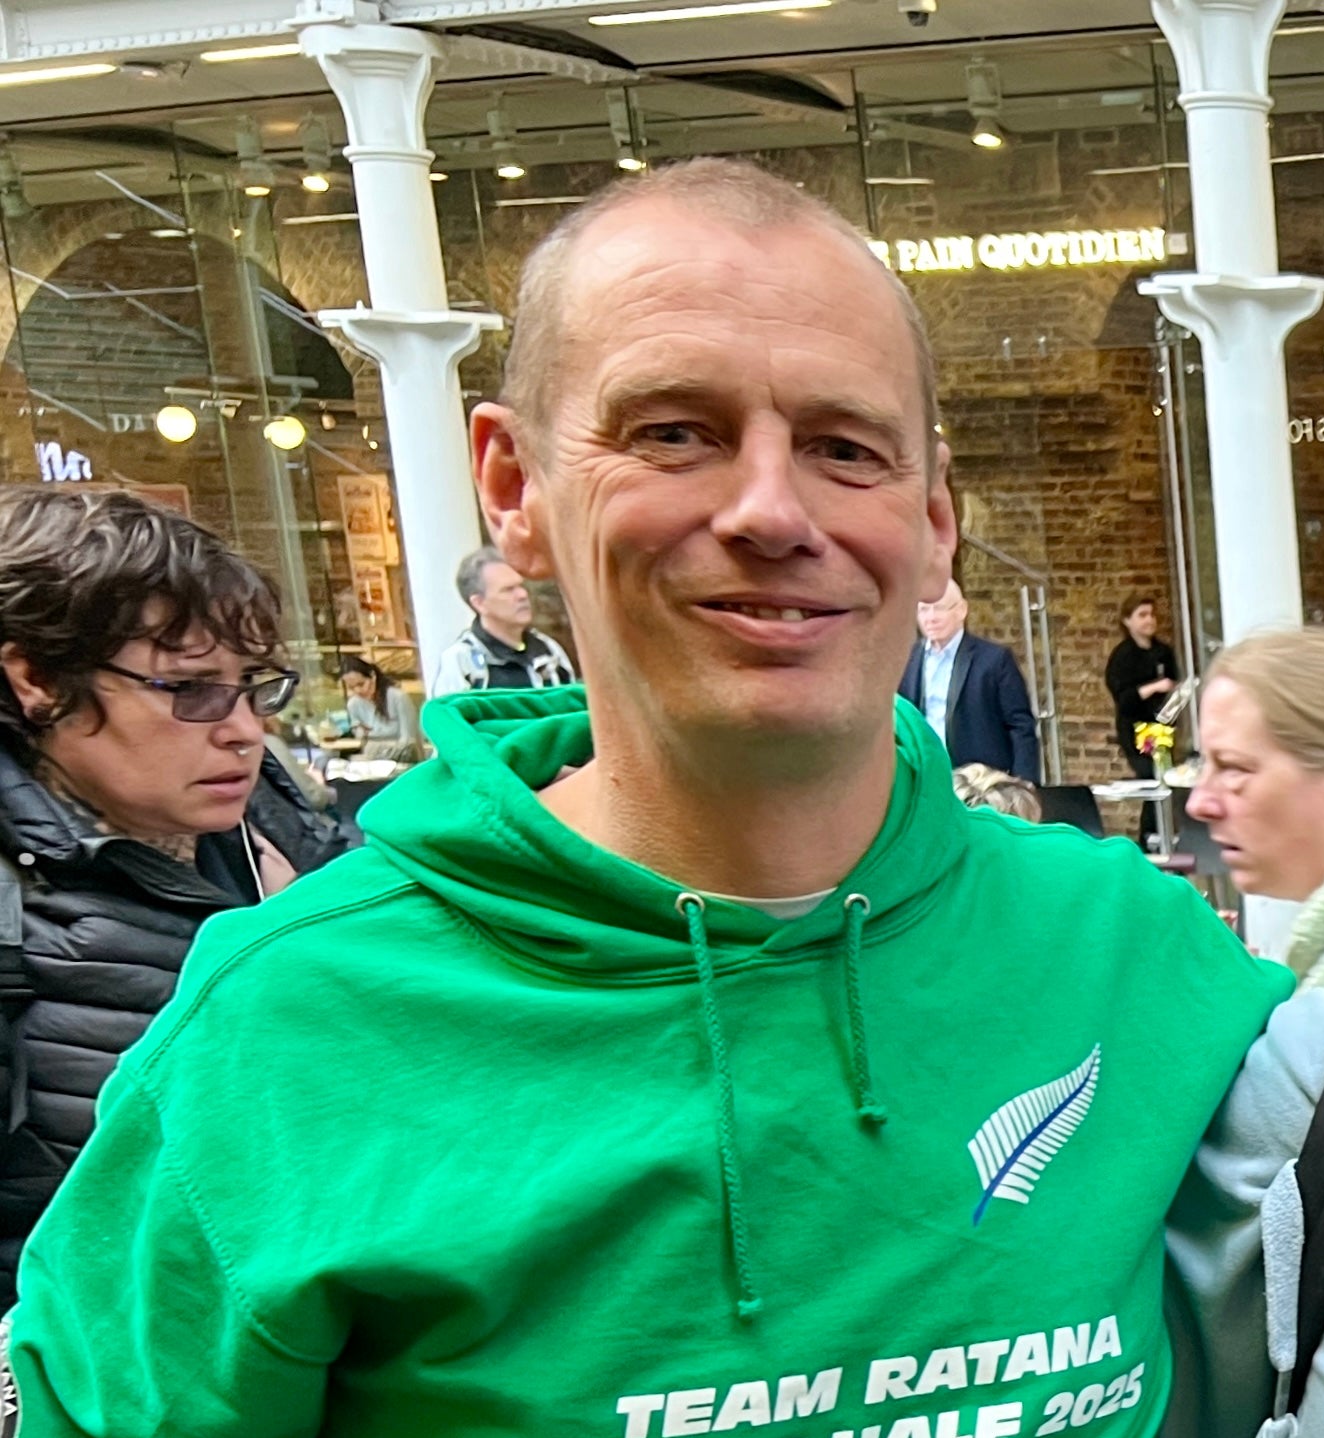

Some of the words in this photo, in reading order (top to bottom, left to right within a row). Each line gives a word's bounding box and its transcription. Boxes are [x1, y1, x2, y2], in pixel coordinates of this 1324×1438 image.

[896, 235, 974, 272] PAIN
[978, 228, 1166, 270] QUOTIDIEN
[864, 1315, 1122, 1405] RATANA
[1035, 1363, 1145, 1438] 2025
